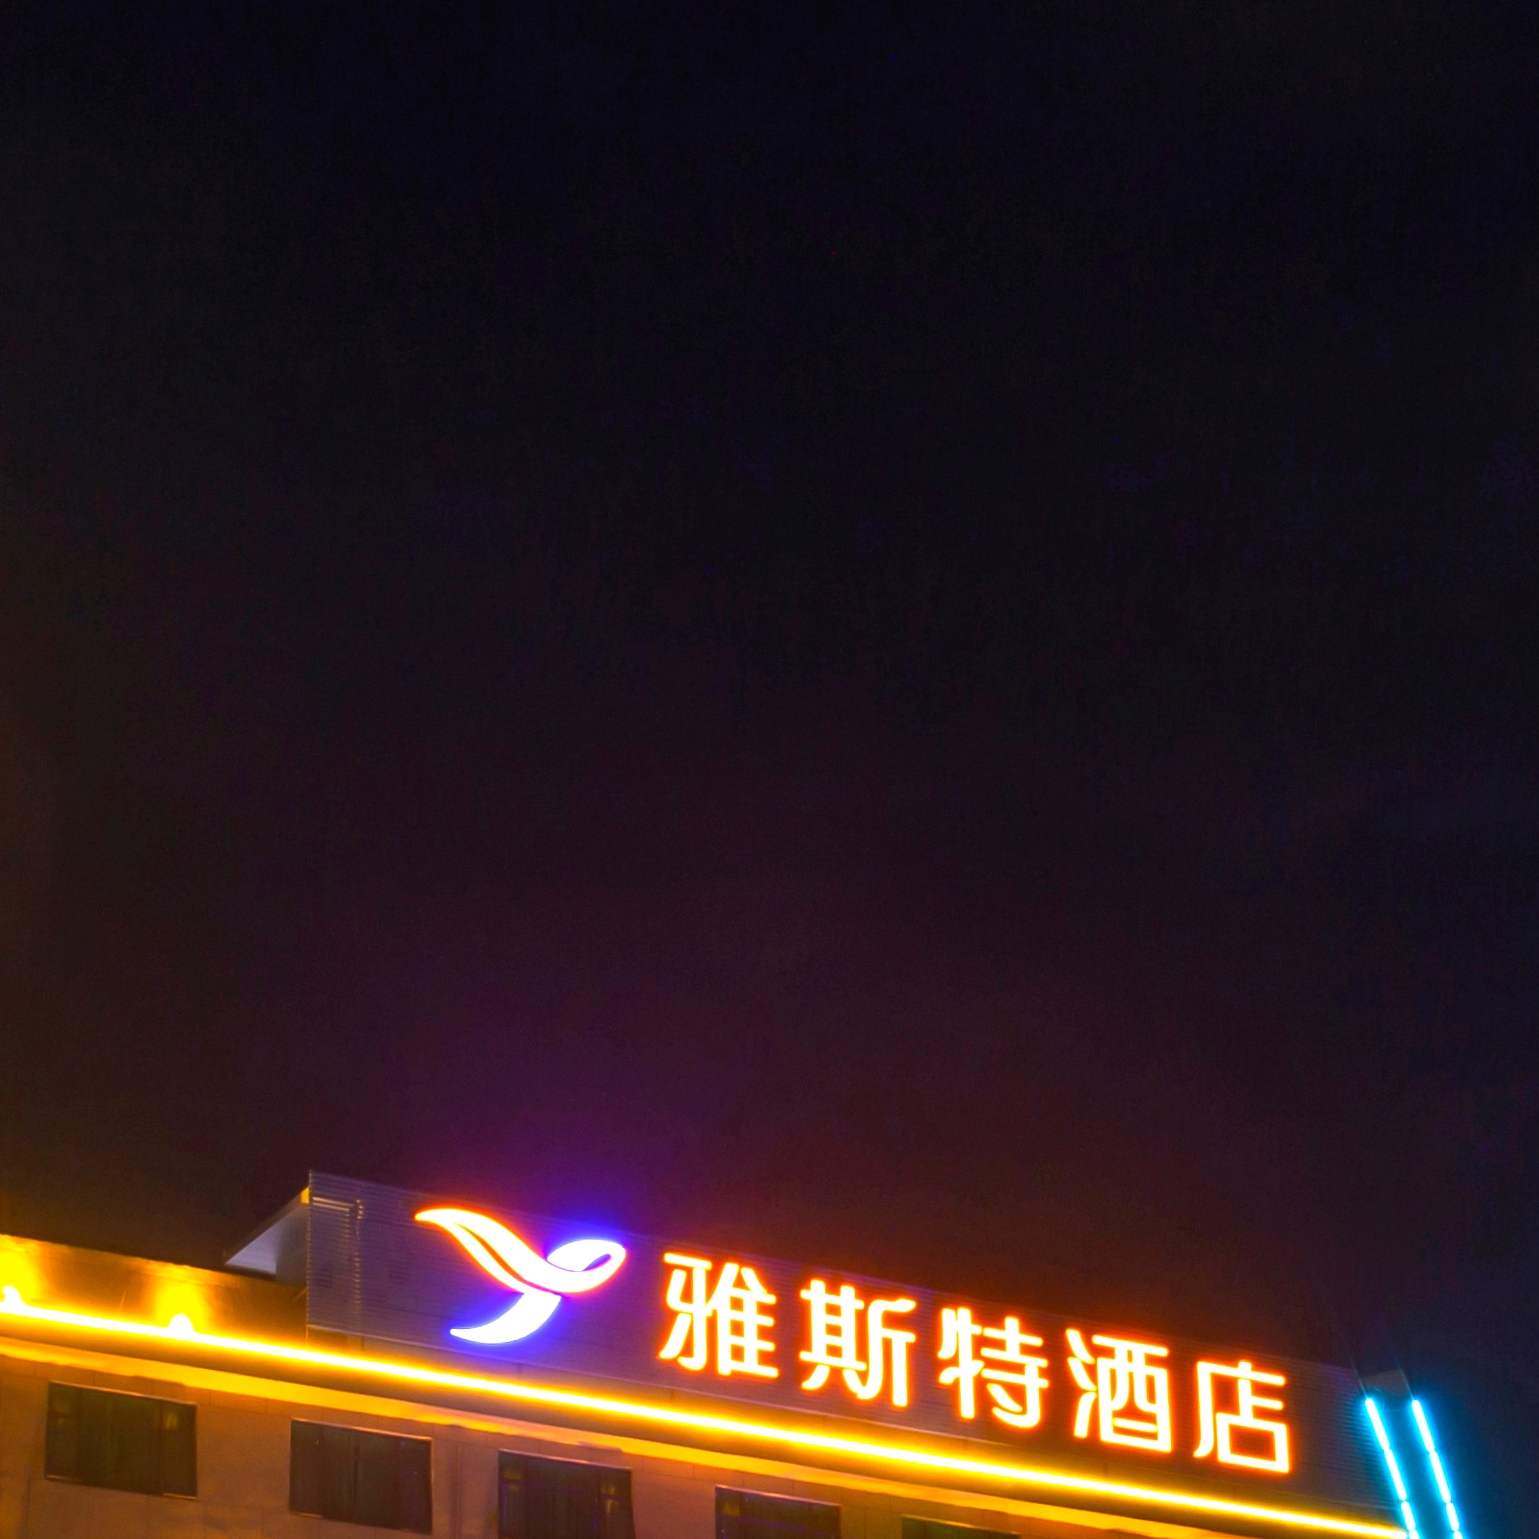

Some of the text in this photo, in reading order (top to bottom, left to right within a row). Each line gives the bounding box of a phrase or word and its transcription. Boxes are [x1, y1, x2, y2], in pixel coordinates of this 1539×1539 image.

[659, 1250, 1292, 1474] 雅斯特酒店
